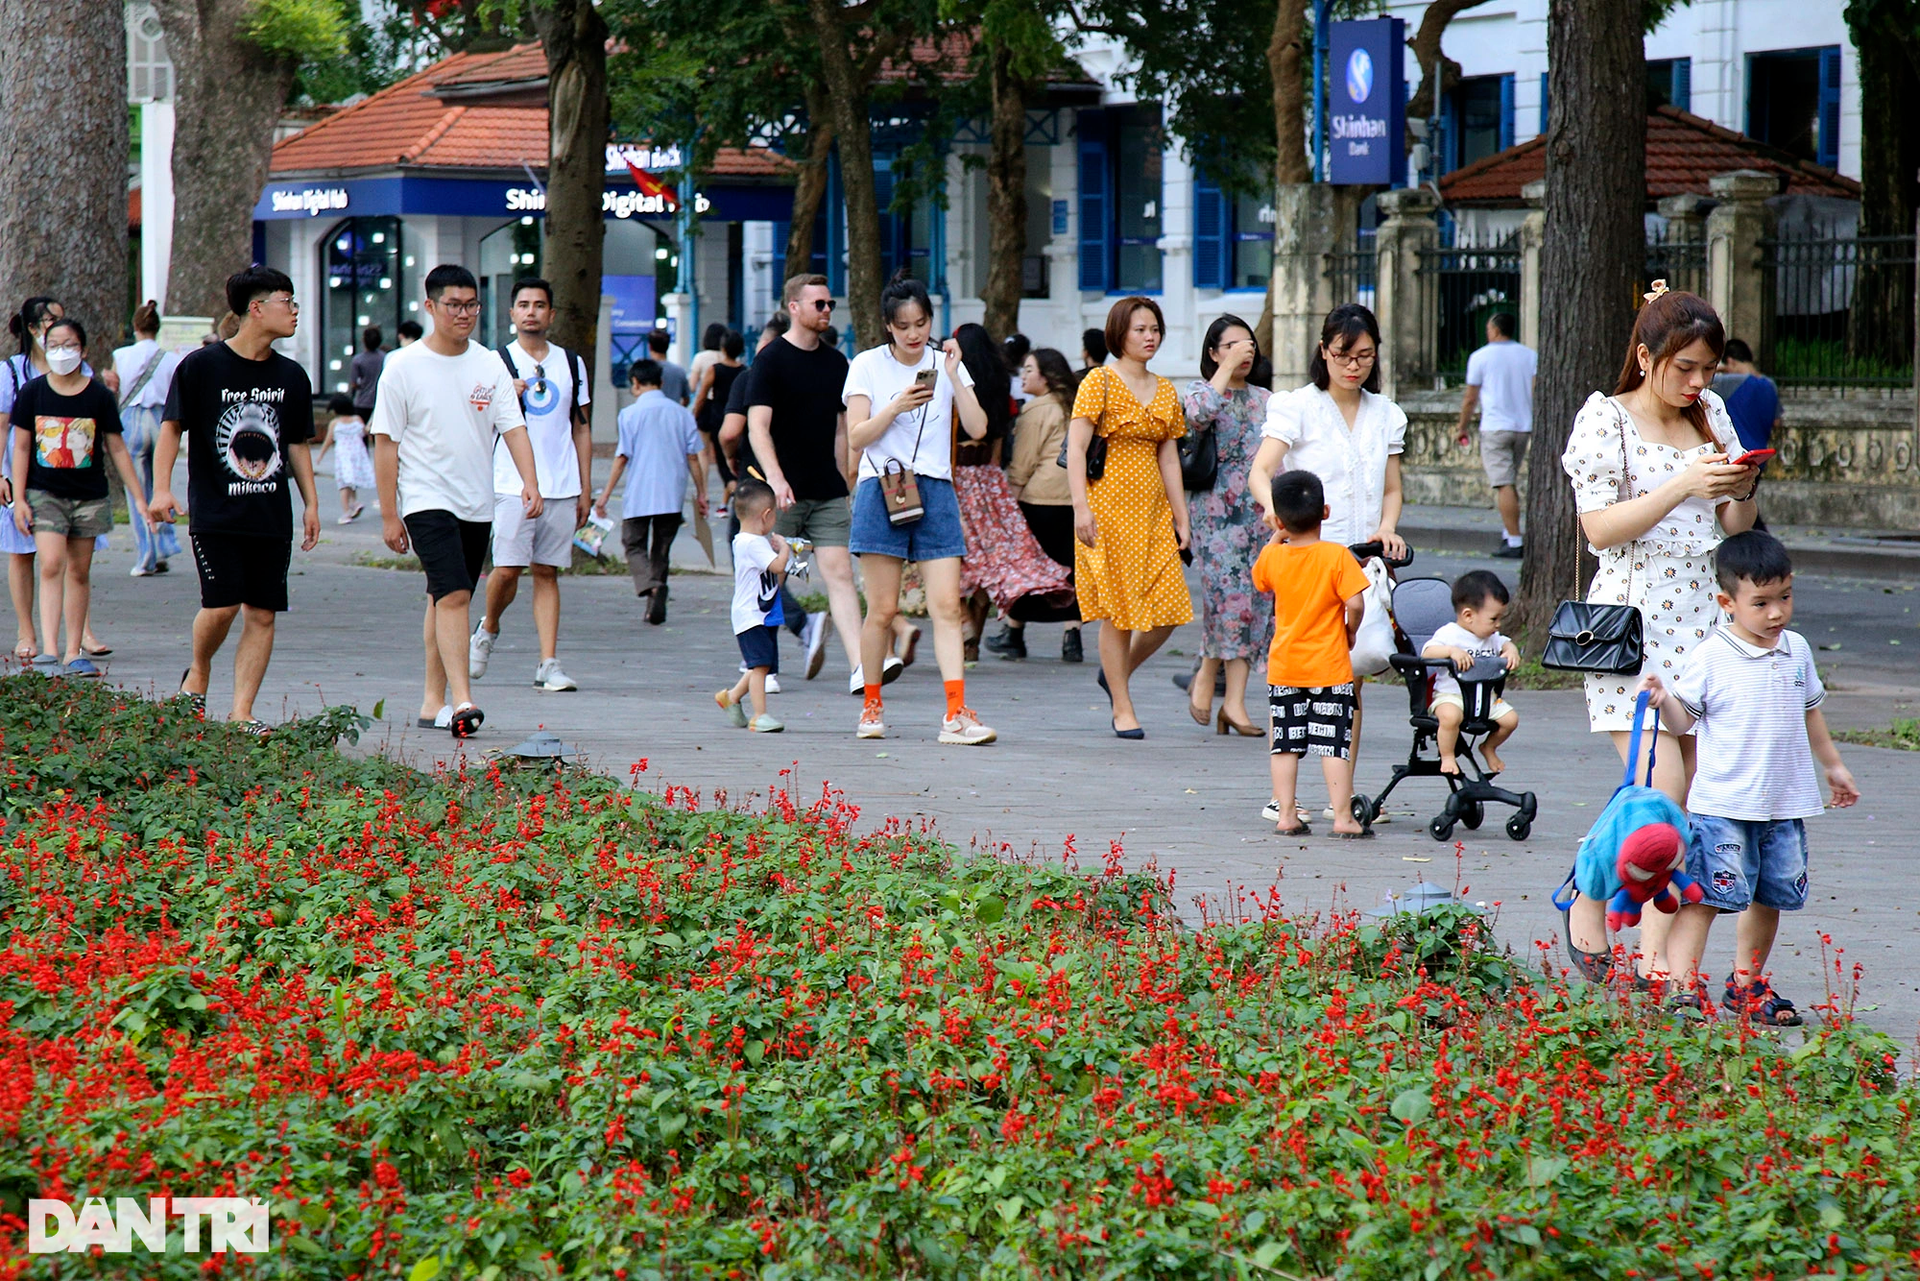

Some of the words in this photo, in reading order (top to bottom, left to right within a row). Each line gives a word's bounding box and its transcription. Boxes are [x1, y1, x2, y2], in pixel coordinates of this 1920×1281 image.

[1332, 114, 1386, 139] Shinhan
[1348, 142, 1370, 156] Bank
[221, 388, 248, 403] Free
[250, 387, 285, 403] Spirit
